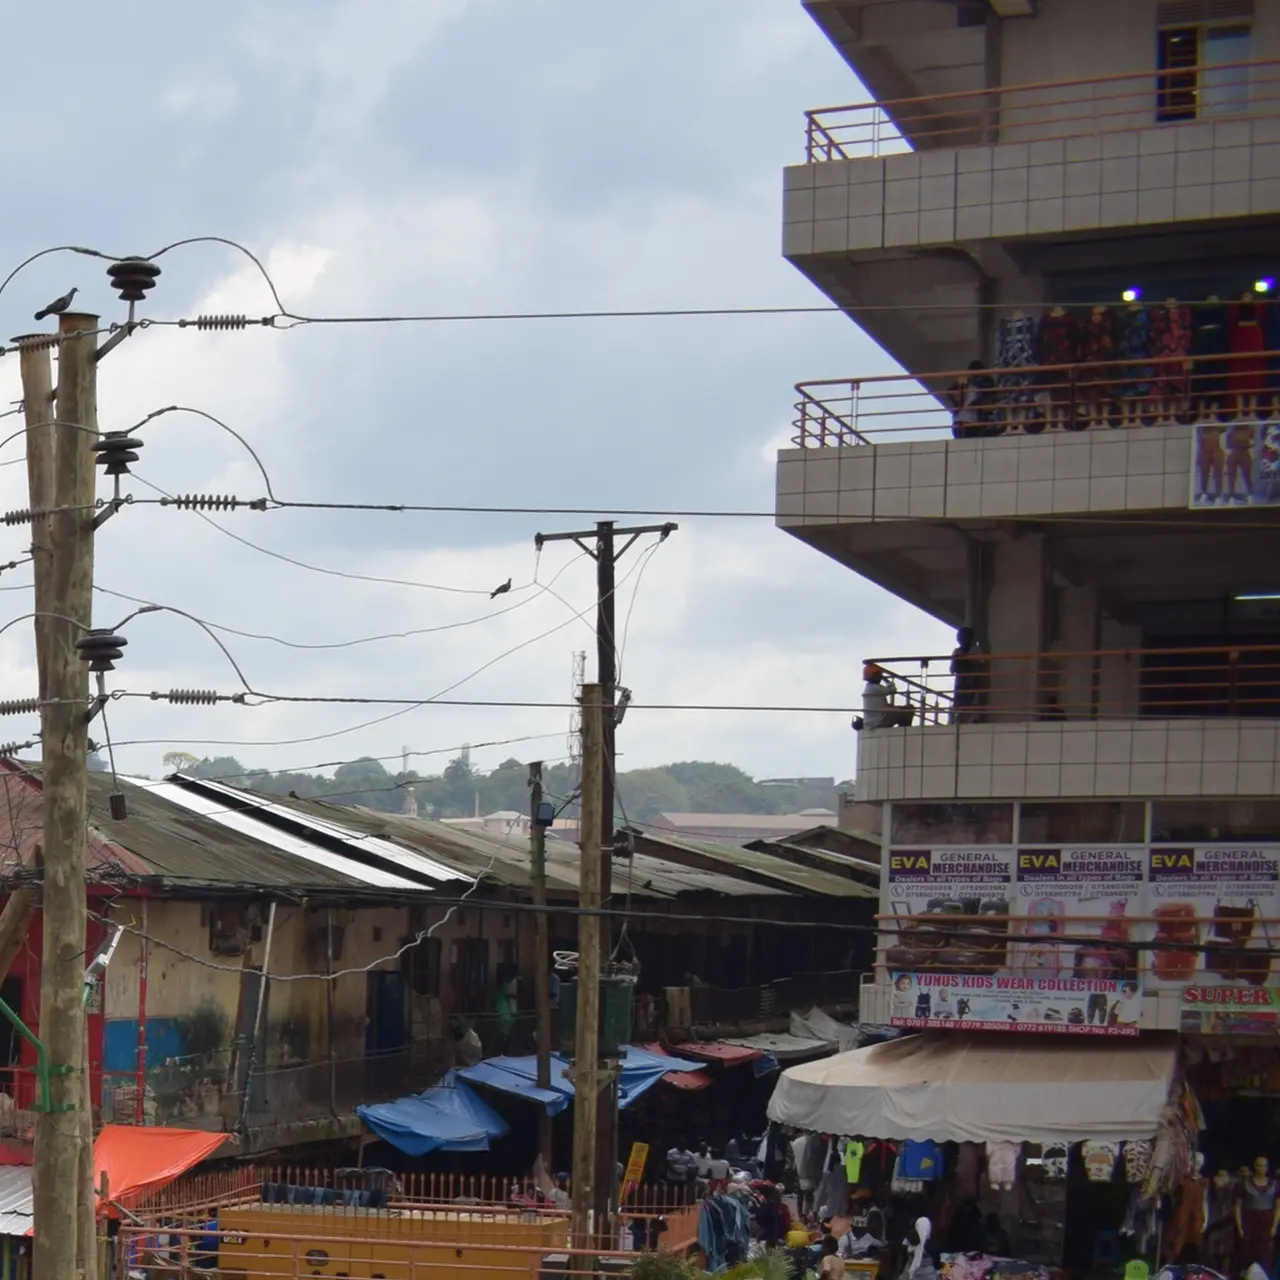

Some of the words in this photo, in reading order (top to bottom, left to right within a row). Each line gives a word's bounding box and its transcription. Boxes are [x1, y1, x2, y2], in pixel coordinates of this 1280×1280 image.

[941, 853, 998, 862] GENERAL
[1070, 851, 1131, 860] GENERAL
[1204, 850, 1266, 859] GENERAL
[891, 856, 929, 868] EVA
[1020, 855, 1058, 868] EVA
[1063, 861, 1143, 872] MERCHANDISE
[1152, 855, 1192, 868] EVA
[1196, 860, 1279, 872] MERCHANDISE
[932, 863, 1011, 874] MERCHANDISE
[916, 974, 959, 988] YUNUS
[962, 976, 993, 989] KIDS
[997, 977, 1034, 990] WEAR
[1038, 979, 1117, 993] COLLECTION
[1184, 985, 1271, 1005] SUPER
[1068, 1025, 1090, 1033] SHOP
